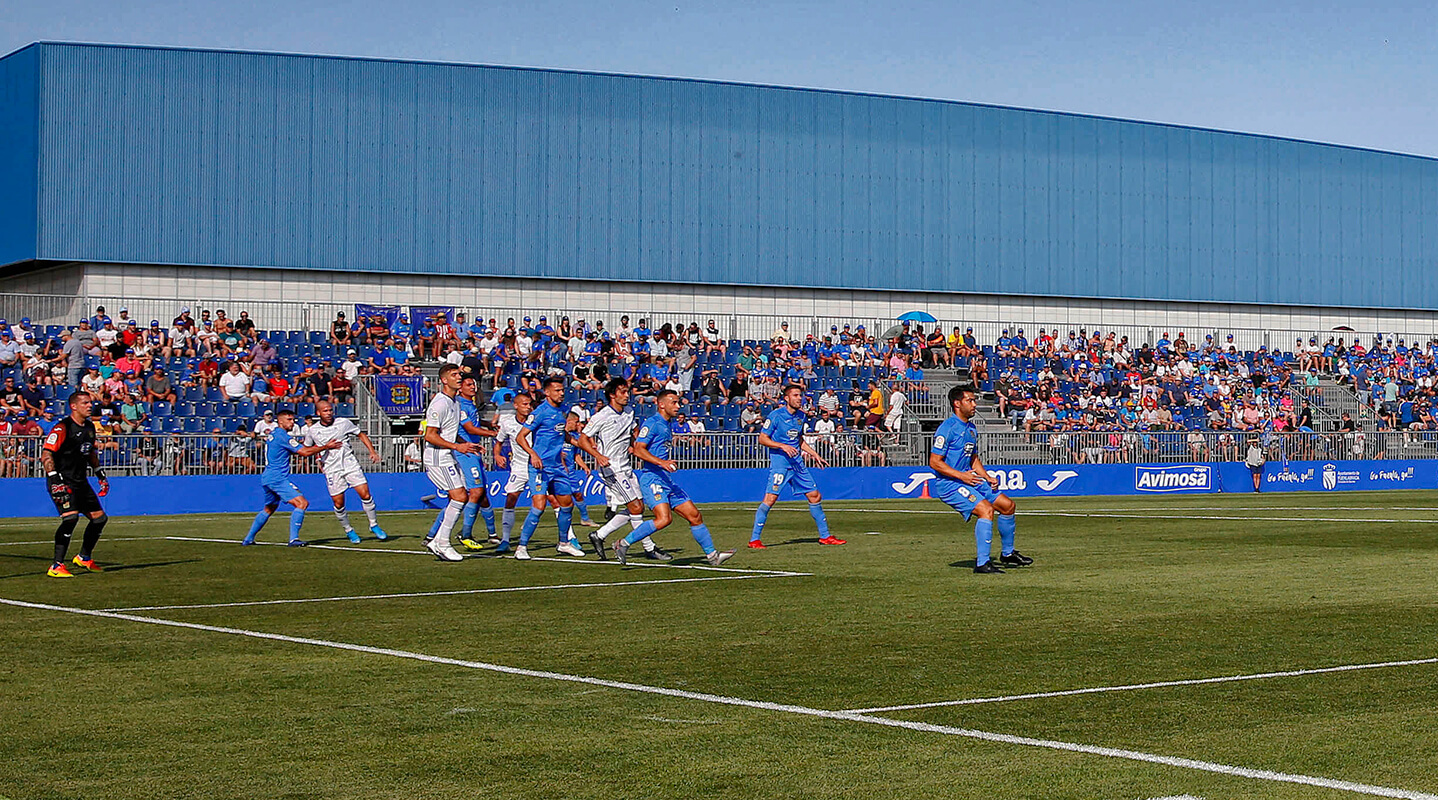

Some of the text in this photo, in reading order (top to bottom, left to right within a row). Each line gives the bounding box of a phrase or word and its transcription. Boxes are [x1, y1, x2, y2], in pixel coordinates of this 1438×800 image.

[447, 465, 456, 477] 5
[470, 467, 480, 479] 5
[621, 478, 632, 491] 3
[773, 473, 786, 486] 19
[985, 469, 1027, 490] ma
[1138, 470, 1207, 488] Avimosa
[957, 486, 971, 498] 8
